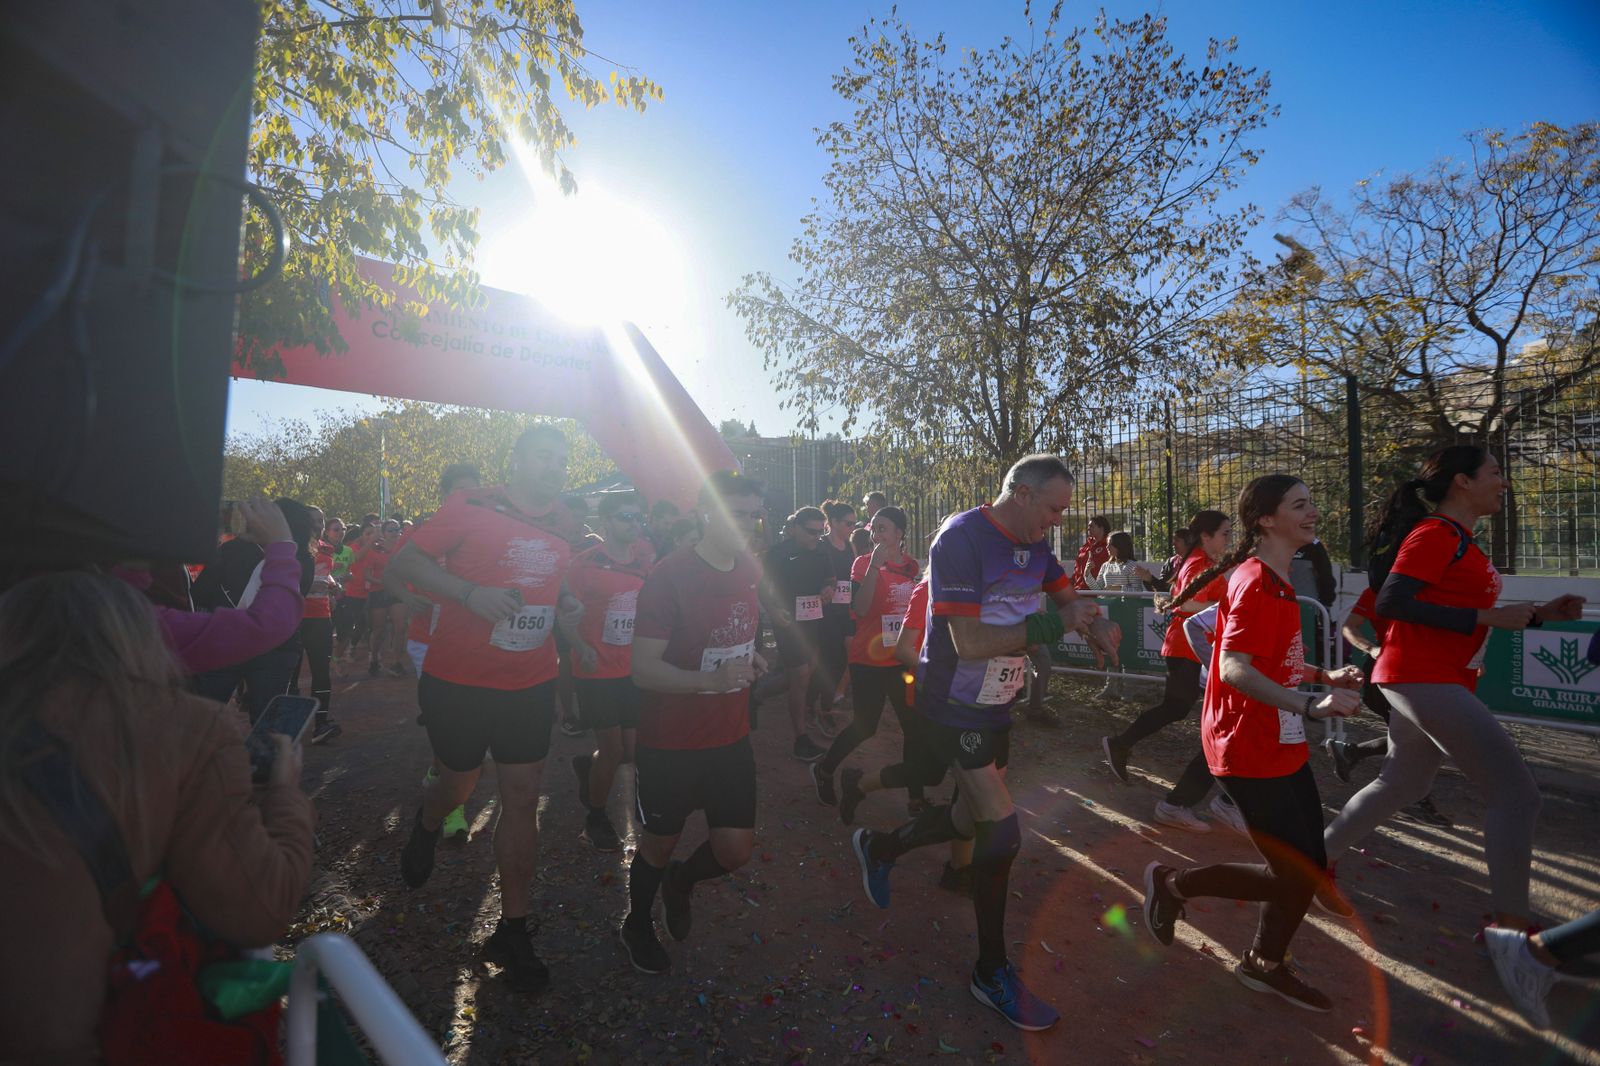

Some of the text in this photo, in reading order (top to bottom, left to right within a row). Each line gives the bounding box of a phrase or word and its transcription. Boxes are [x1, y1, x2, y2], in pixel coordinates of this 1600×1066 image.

[371, 319, 593, 372] Cocejalía de Deportes
[507, 615, 546, 631] 1650
[1057, 643, 1079, 653] CAJA
[1136, 649, 1161, 660] CAJA
[1512, 630, 1522, 685] fundación
[1512, 687, 1551, 700] CAJA
[1533, 700, 1594, 713] GRANADA
